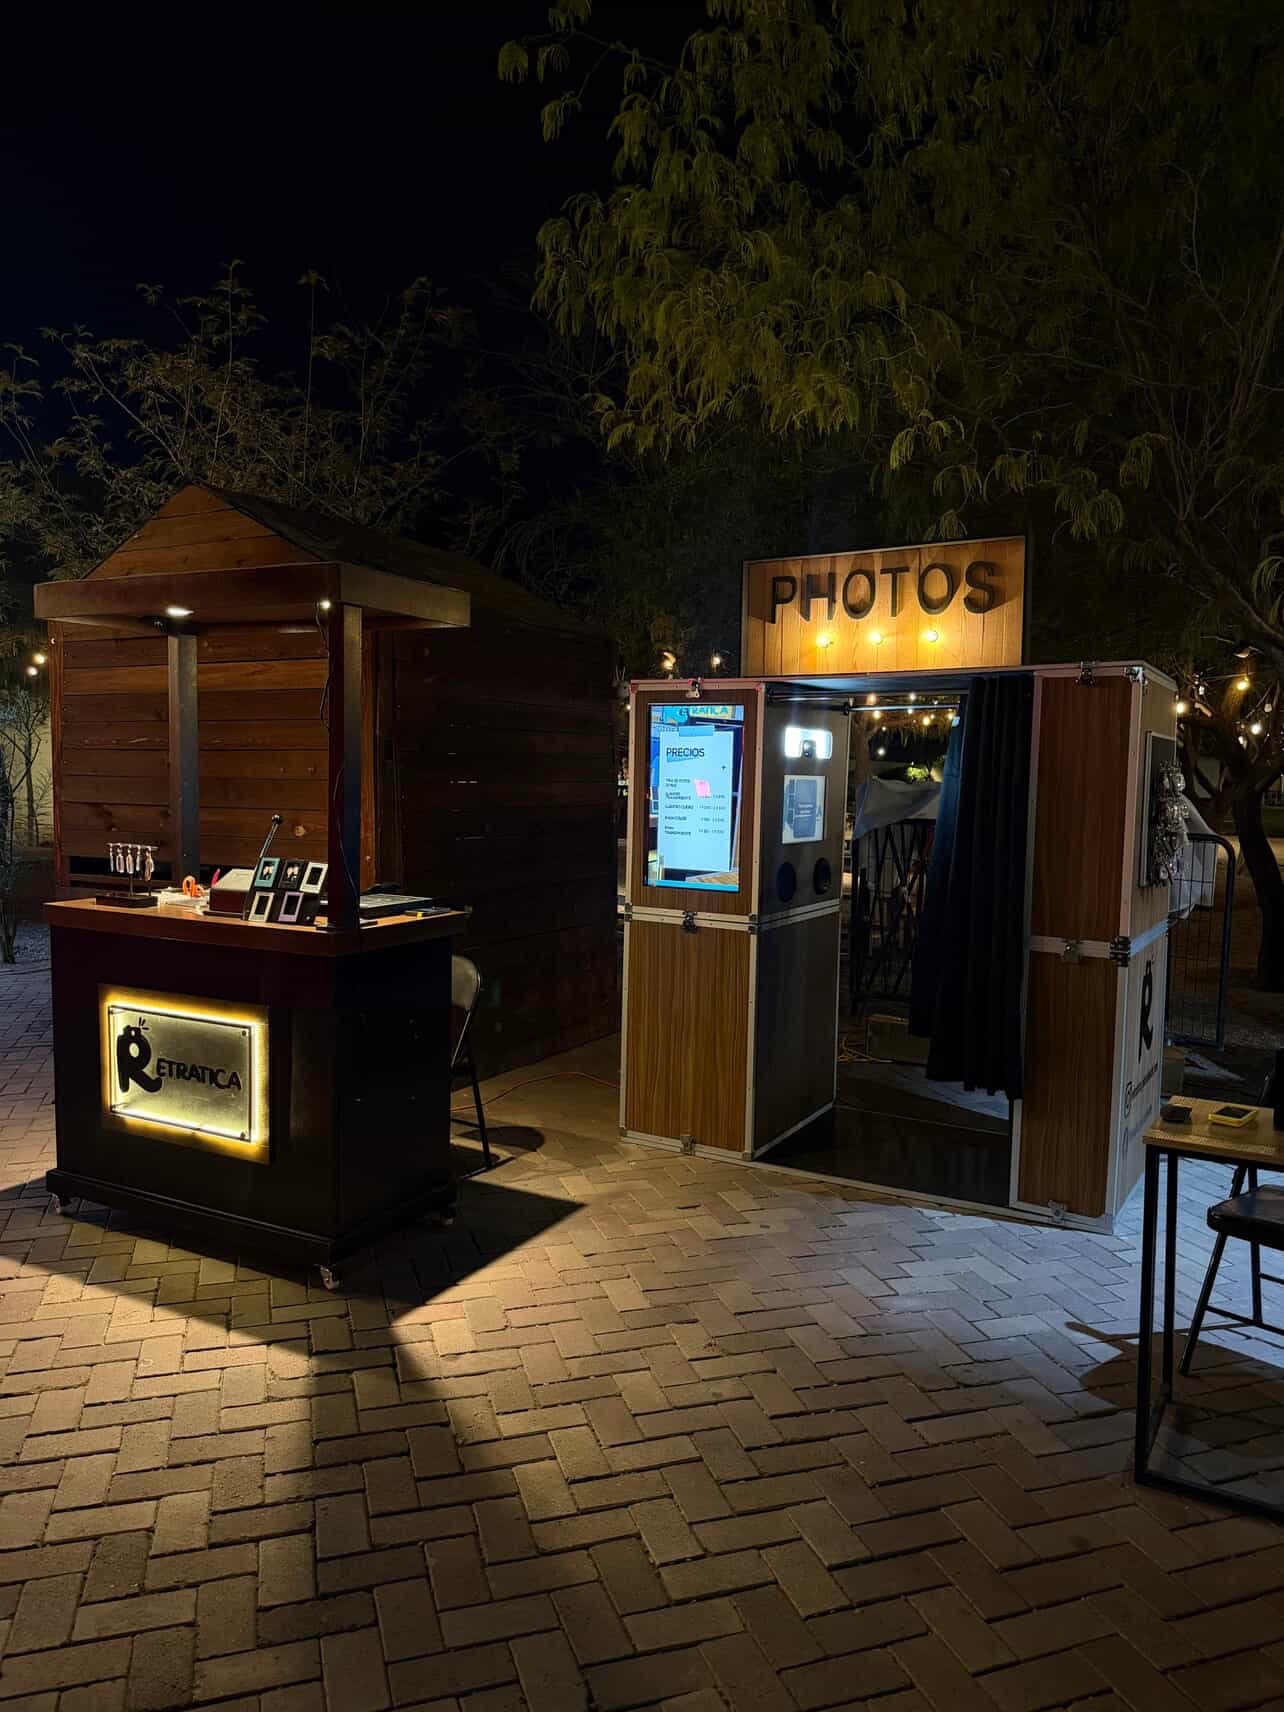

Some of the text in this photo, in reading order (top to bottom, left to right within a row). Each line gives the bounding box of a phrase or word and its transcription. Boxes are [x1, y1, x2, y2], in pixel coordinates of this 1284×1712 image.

[767, 560, 996, 624] PHOTOS
[666, 747, 705, 757] PRECIOS
[116, 1026, 242, 1093] RETRATICA
